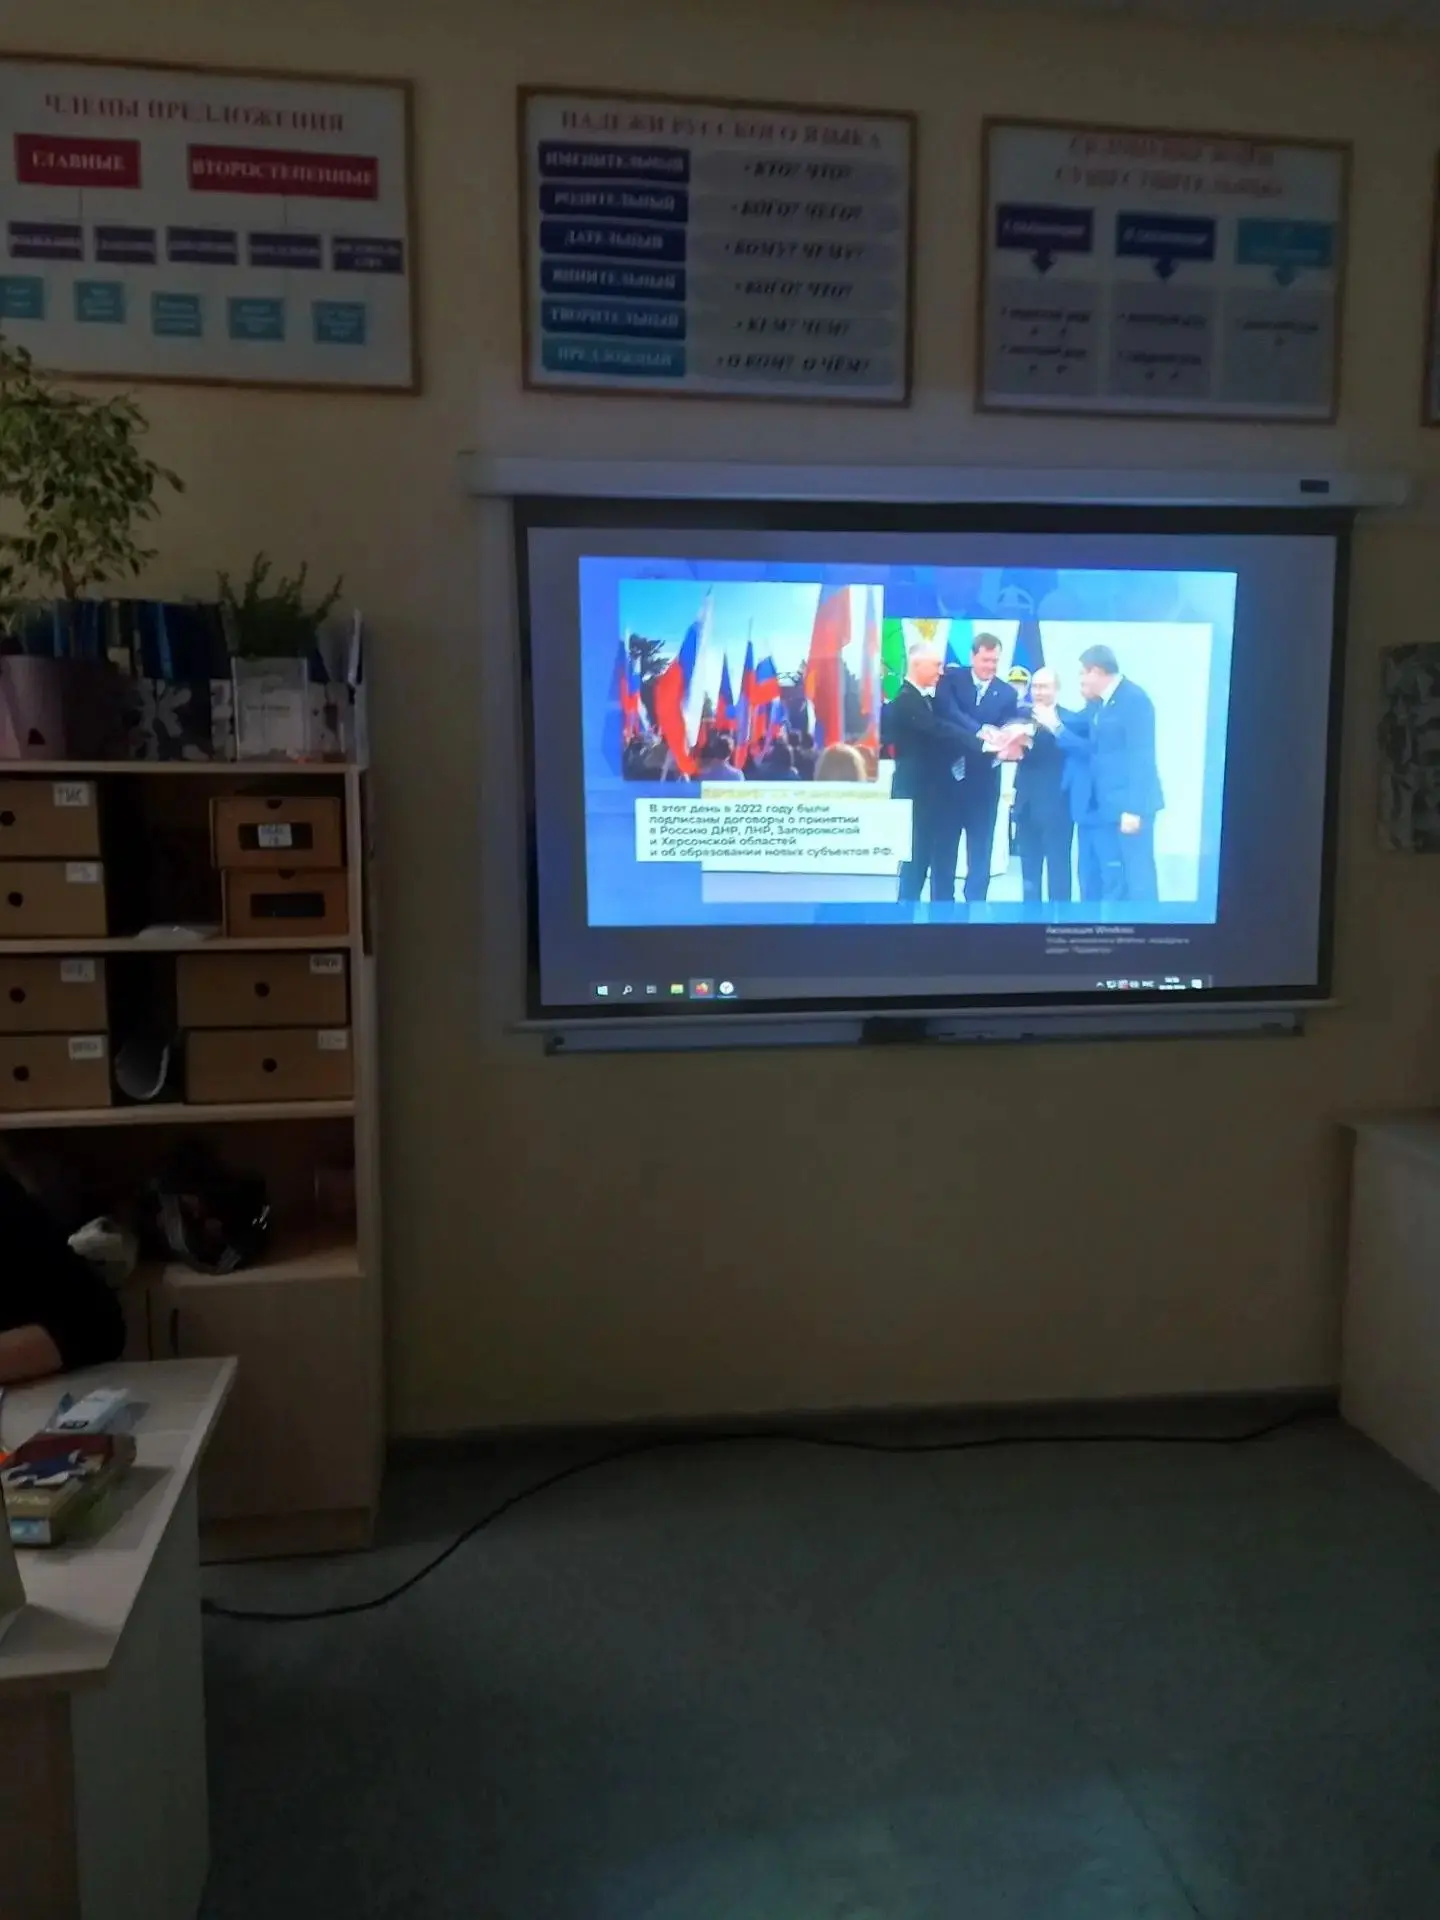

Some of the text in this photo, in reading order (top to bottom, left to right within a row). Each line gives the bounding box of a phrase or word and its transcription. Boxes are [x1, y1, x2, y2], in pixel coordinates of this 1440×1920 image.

[45, 93, 344, 134] ЧЛЕНЫ ПРЕДЛОЖЕНИЯ
[32, 150, 126, 173] ГЛАВНЫЕ
[193, 160, 373, 187] ВТОРОСТЕПЕННЫЕ
[649, 804, 658, 813] В
[662, 805, 687, 813] этот
[690, 805, 721, 815] день
[735, 804, 762, 814] 2022
[766, 805, 794, 816] году
[797, 804, 830, 813] были
[649, 816, 860, 826] подписаны договоры о принятии
[660, 825, 708, 835] Россию
[711, 826, 741, 837] ДНР,
[777, 825, 861, 837] Запорожской
[650, 835, 797, 847] и Херсонской областей
[650, 849, 657, 857] и
[661, 847, 676, 856] об
[680, 848, 761, 858] образовании
[765, 848, 802, 857] новых
[807, 848, 870, 859] субъектов
